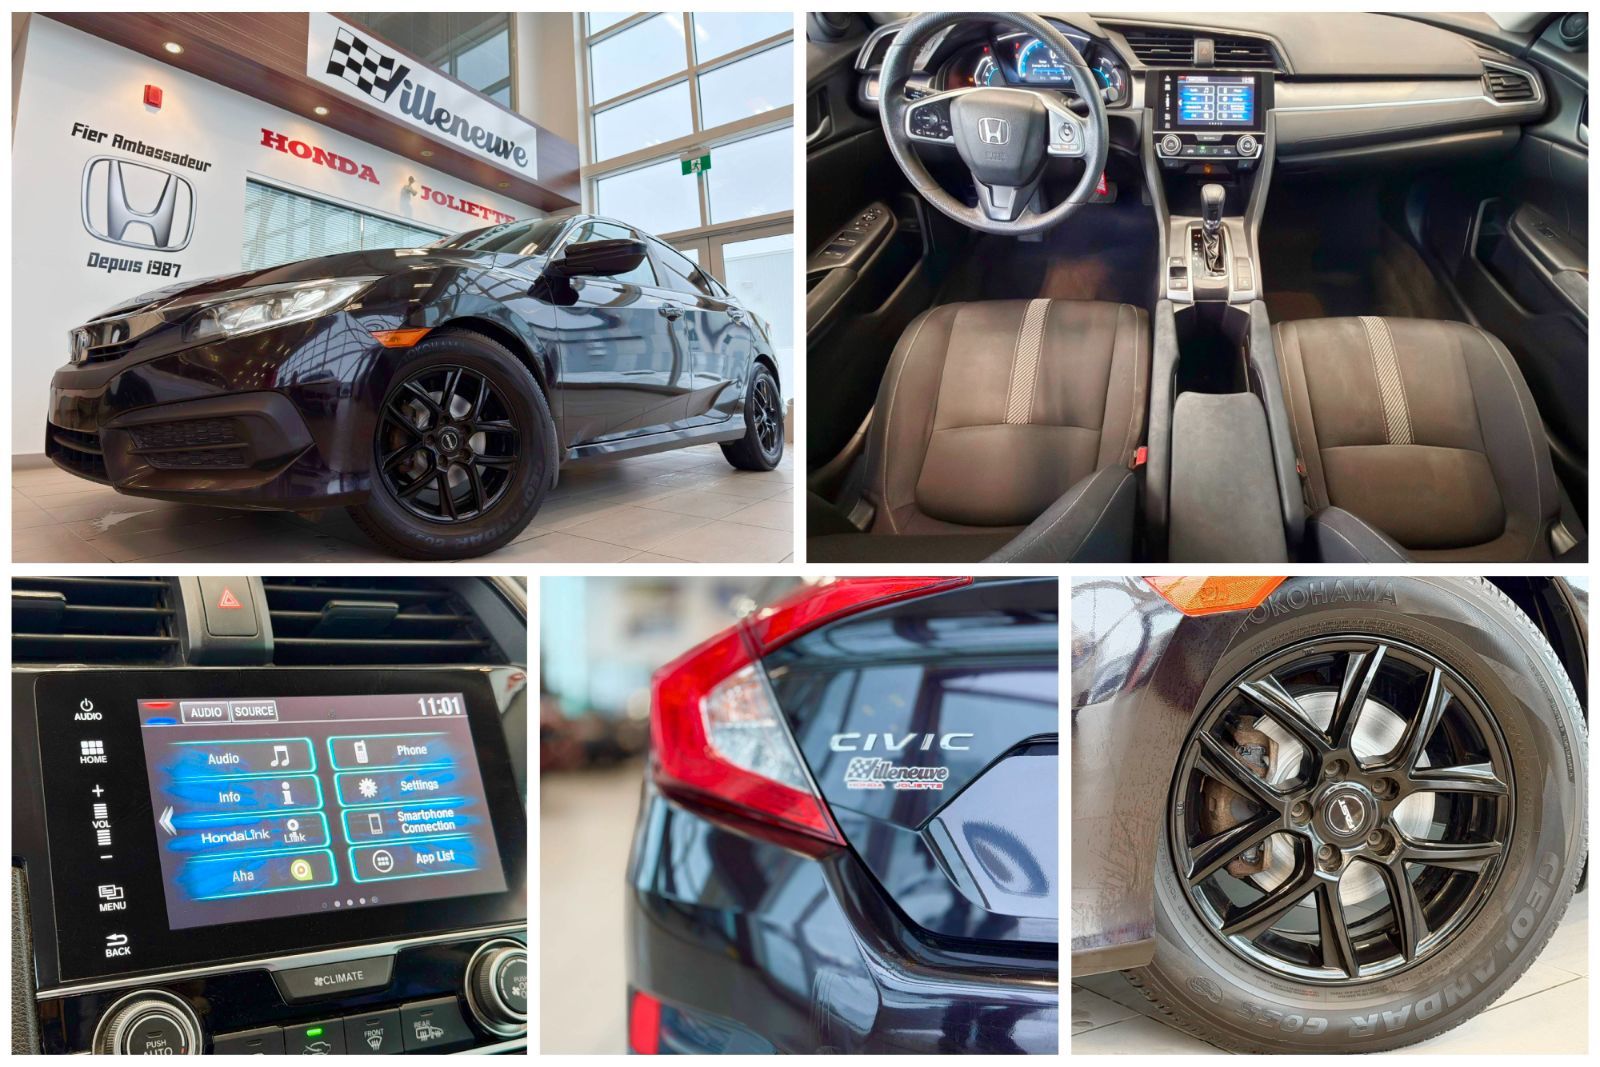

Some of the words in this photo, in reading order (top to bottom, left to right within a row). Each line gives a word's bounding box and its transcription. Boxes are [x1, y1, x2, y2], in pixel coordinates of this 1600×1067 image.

[326, 26, 529, 168] Villeneuve
[71, 122, 108, 144] Fier
[111, 133, 212, 172] Ambassadeur
[260, 128, 380, 185] HONDA
[86, 251, 143, 273] Depuis
[146, 260, 182, 278] 1987
[190, 706, 222, 719] AUDIO
[234, 705, 275, 718] SOURCE
[418, 696, 461, 716] 11:01
[74, 712, 103, 721] AUDIO
[830, 732, 975, 752] CIVIC
[397, 744, 428, 756] Phone
[80, 755, 108, 764] HOME
[208, 752, 240, 765] Audio
[846, 757, 948, 782] Villeneuve
[400, 779, 439, 793] Settings
[218, 791, 241, 803] Info
[397, 807, 455, 826] Smartphone
[92, 820, 112, 829] VOL
[401, 819, 456, 835] Connection
[201, 828, 270, 845] HondaLink
[415, 852, 436, 867] App
[437, 849, 456, 863] List
[232, 869, 255, 882] Aha
[99, 901, 127, 912] MENU
[105, 946, 132, 958] BACK
[323, 970, 365, 986] CLIMATE
[364, 1028, 384, 1039] FRONT
[146, 1039, 167, 1050] PUSH
